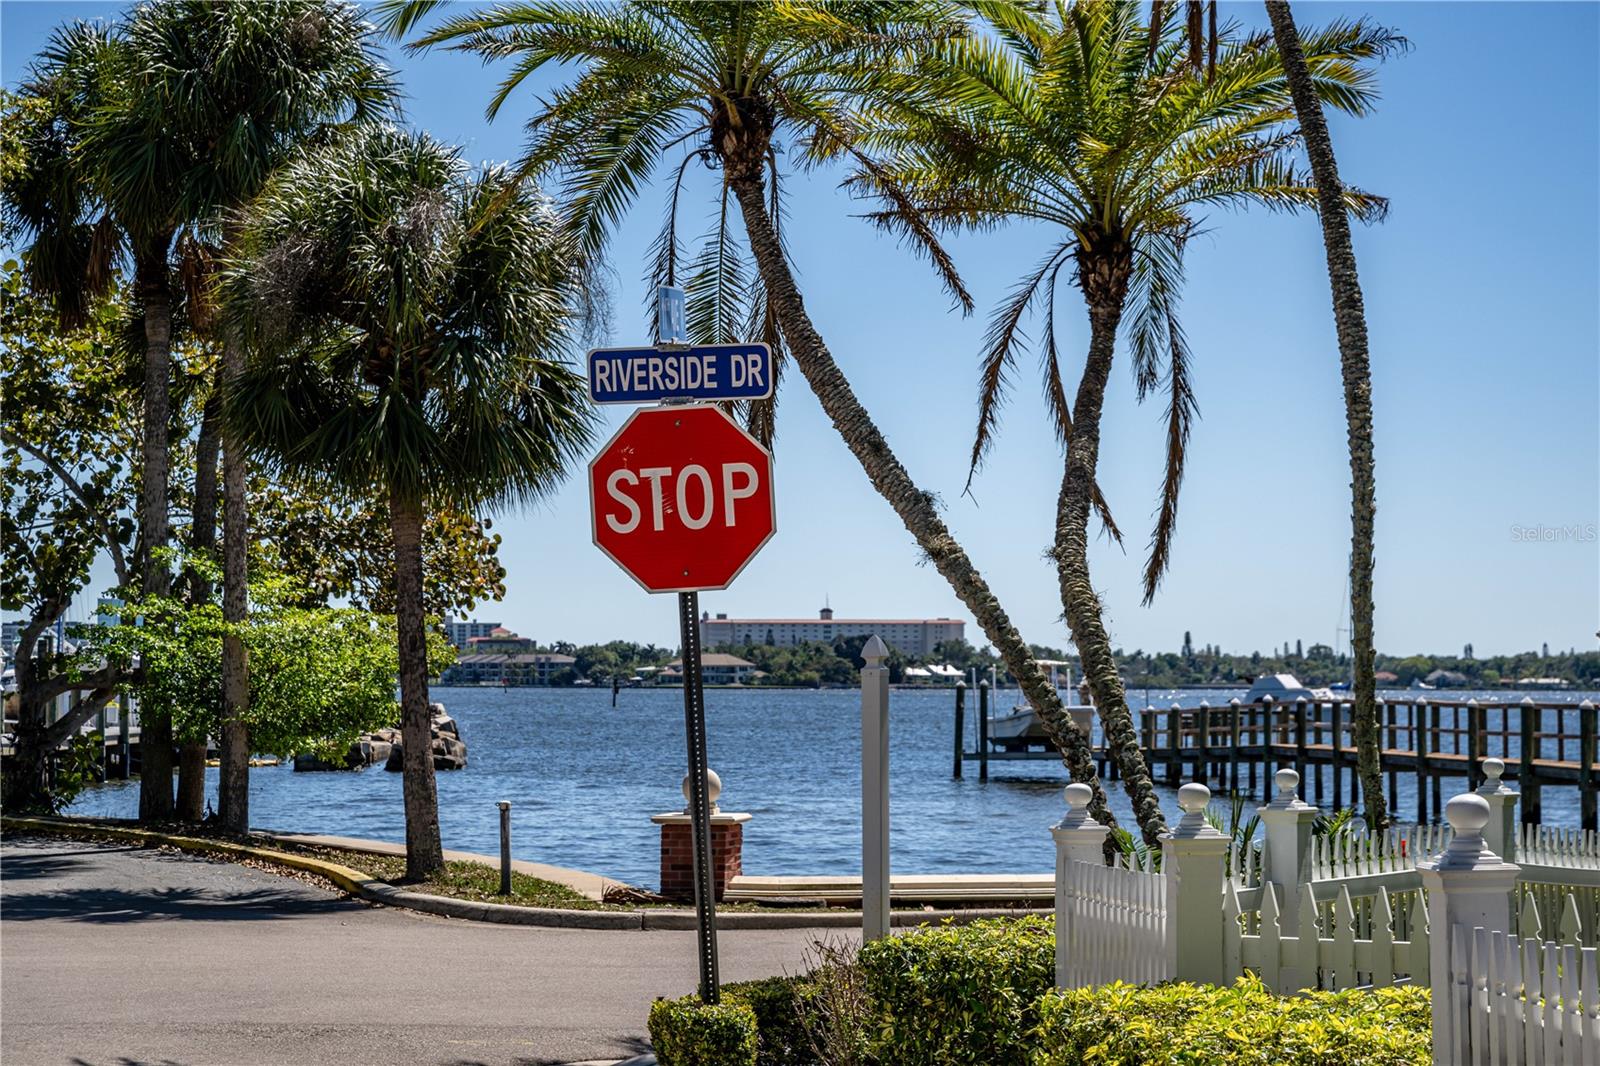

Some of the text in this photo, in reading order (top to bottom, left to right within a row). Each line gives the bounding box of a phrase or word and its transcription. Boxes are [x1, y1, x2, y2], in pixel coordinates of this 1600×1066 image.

[595, 353, 764, 392] RIVERSIDE DR
[605, 462, 759, 534] STOP
